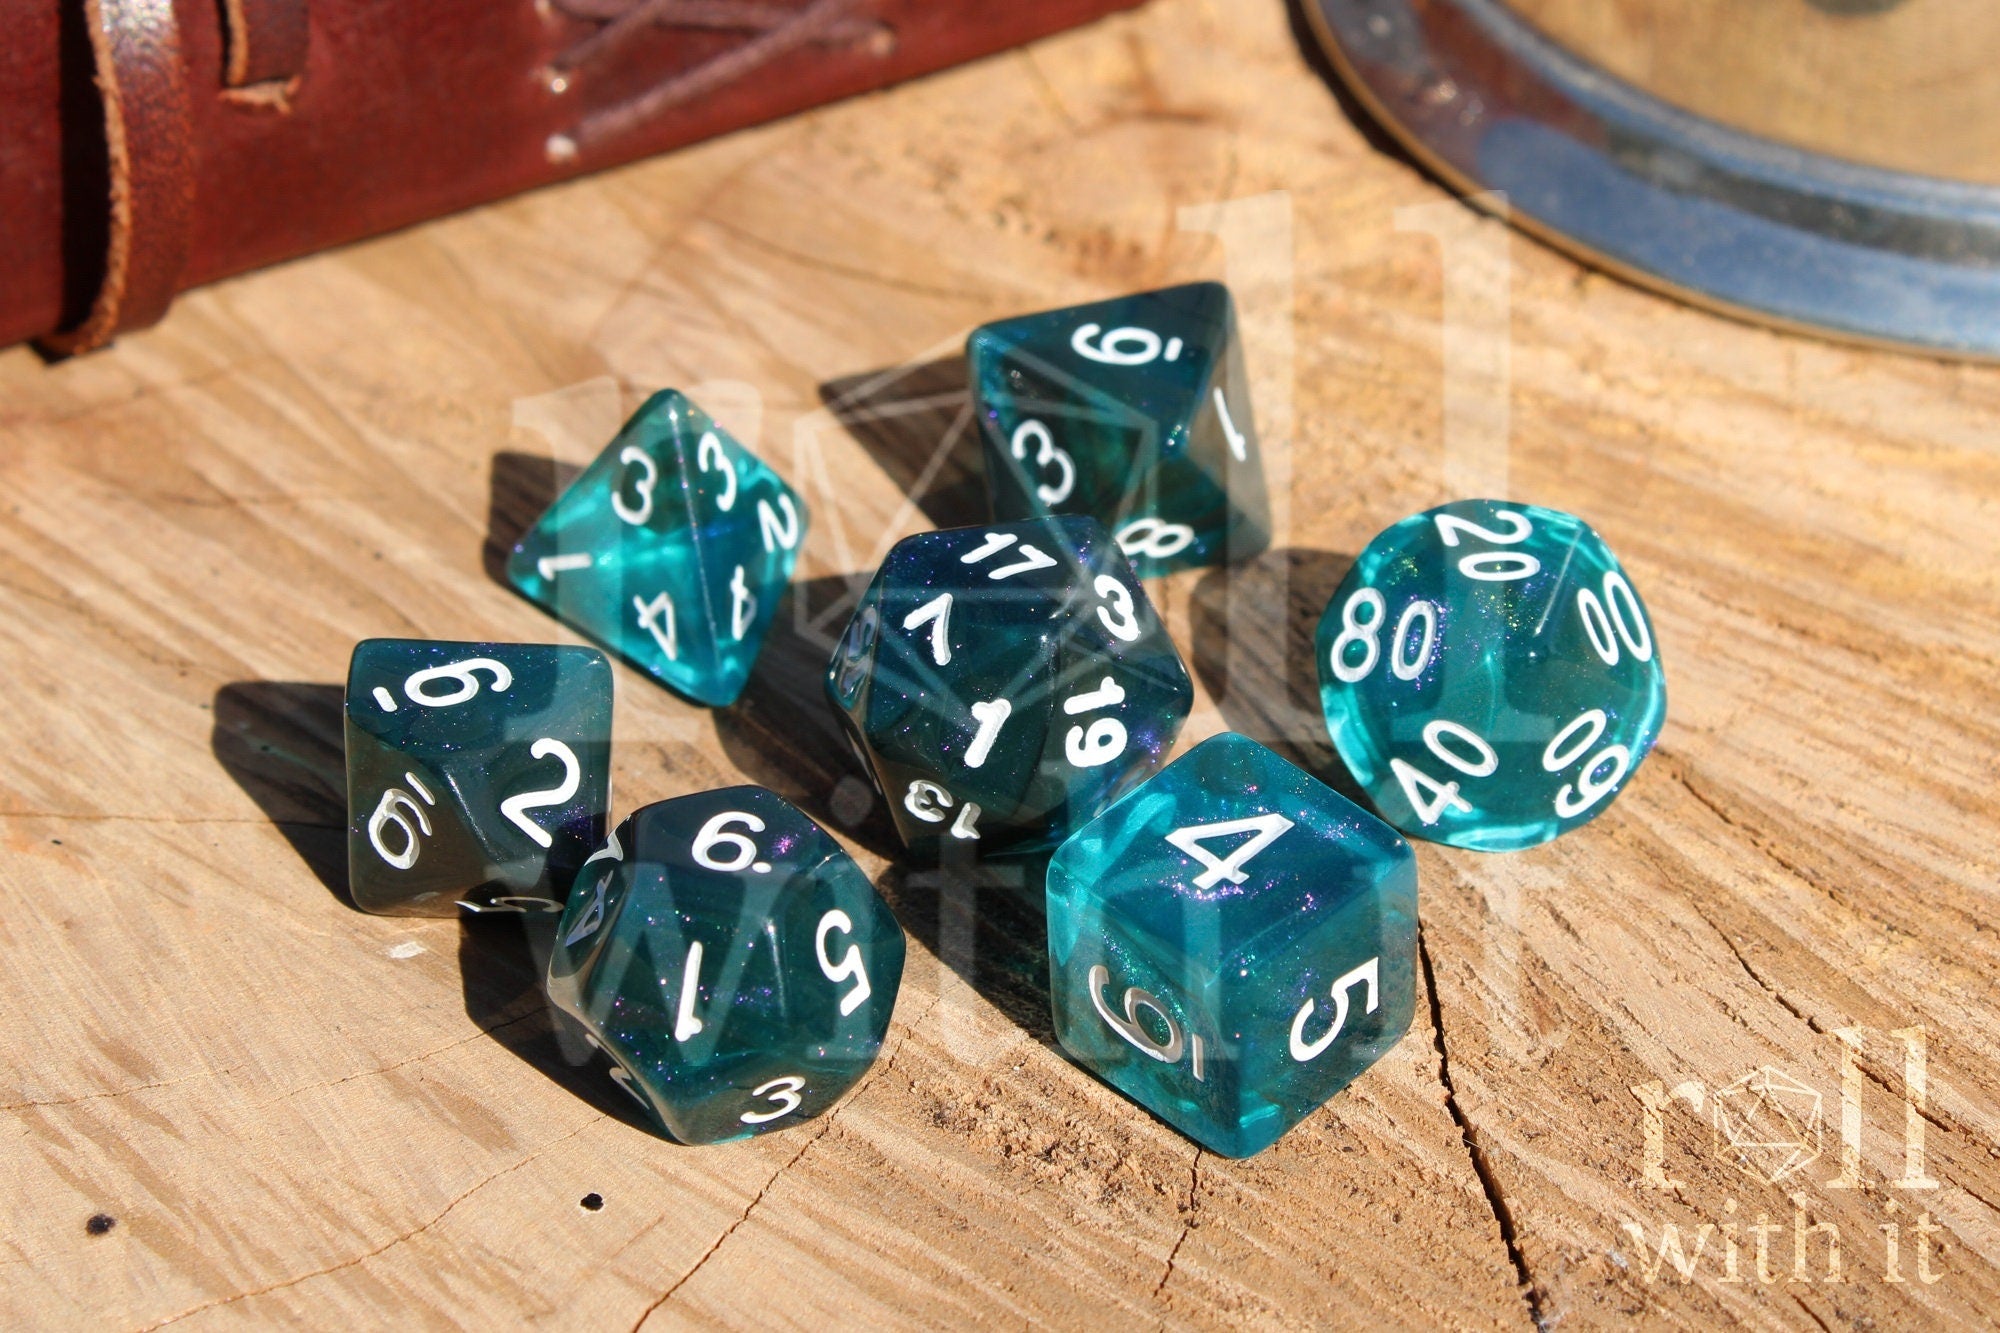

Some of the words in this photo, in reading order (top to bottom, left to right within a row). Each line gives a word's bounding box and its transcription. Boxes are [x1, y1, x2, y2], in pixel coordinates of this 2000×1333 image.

[1011, 419, 1077, 504] 3
[1214, 386, 1246, 462] 1
[611, 445, 657, 526] 3
[698, 432, 737, 512] 3
[757, 493, 799, 553] 2
[961, 531, 1058, 579] 17
[1115, 517, 1195, 558] 8
[1434, 509, 1541, 582] 20
[537, 552, 593, 581] 1
[730, 564, 758, 641] 4
[633, 590, 677, 661] 4
[903, 593, 953, 666] 7
[1094, 574, 1140, 642] 3
[1330, 586, 1437, 683] 80
[1577, 570, 1652, 666] 00
[963, 698, 1011, 768] 1
[1063, 676, 1128, 768] 19
[500, 737, 581, 848] 2
[904, 779, 981, 840] 13
[1390, 719, 1499, 825] 40
[1164, 813, 1295, 890] 4
[675, 940, 702, 1042] 1
[815, 909, 871, 1017] 5
[1289, 956, 1380, 1062] 5
[740, 1076, 806, 1124] 3
